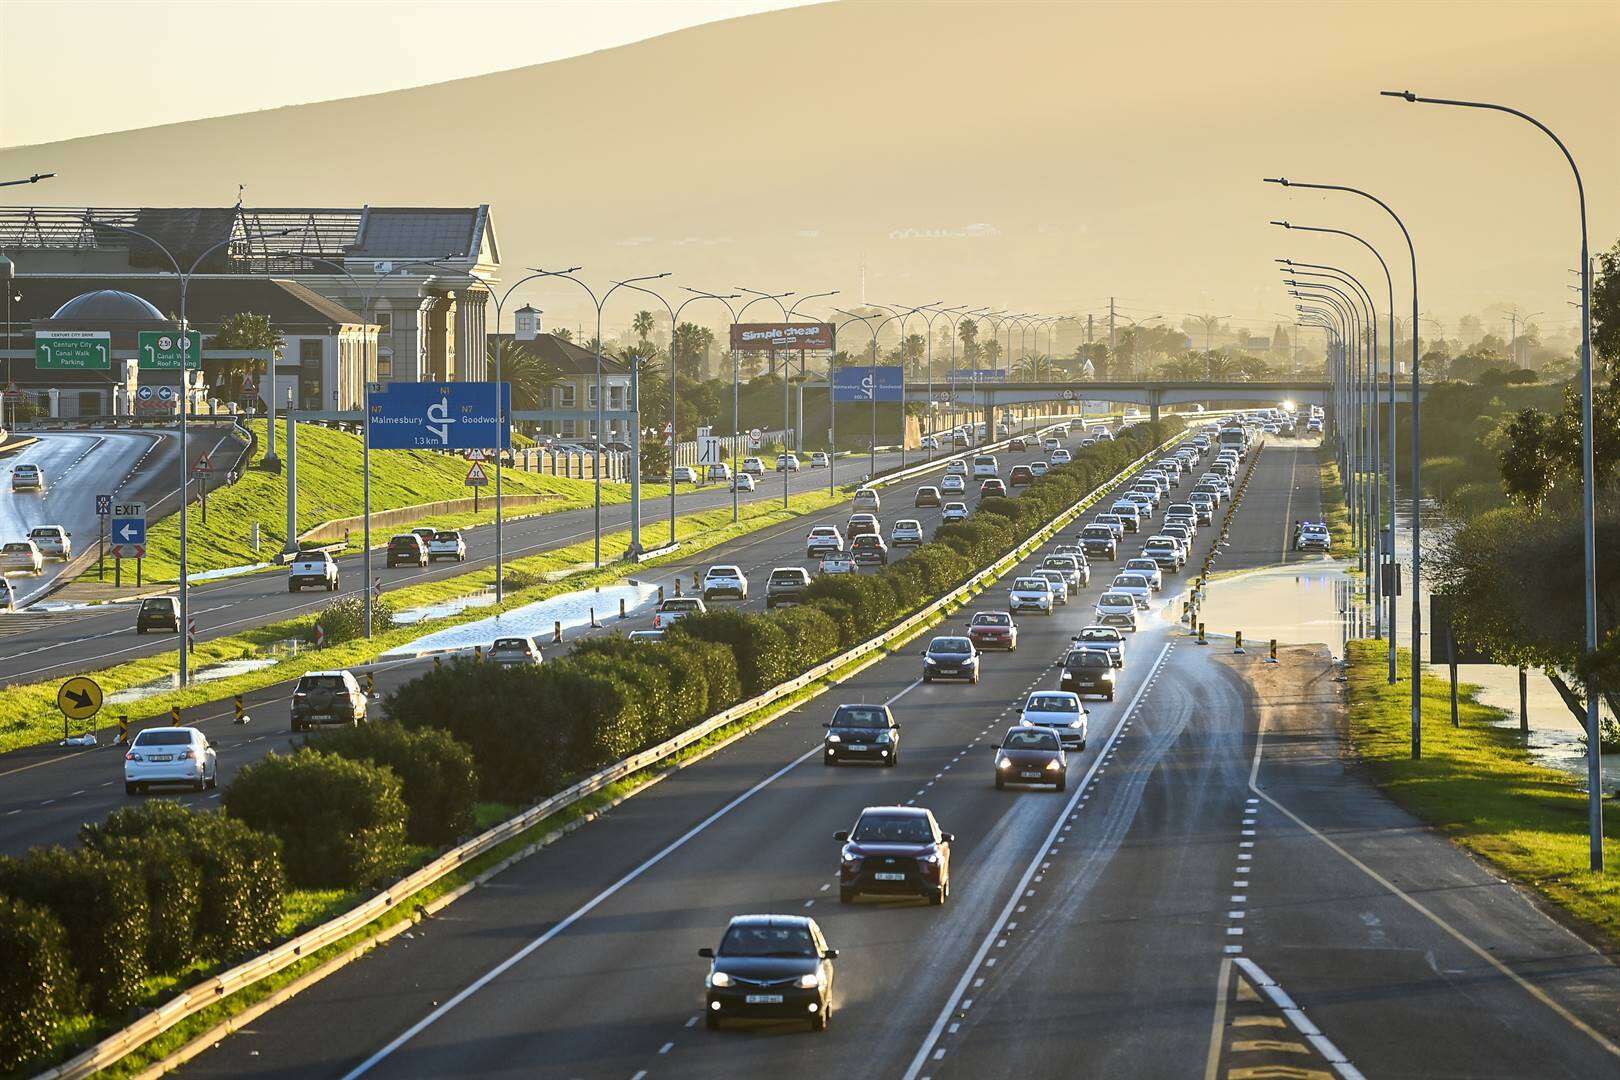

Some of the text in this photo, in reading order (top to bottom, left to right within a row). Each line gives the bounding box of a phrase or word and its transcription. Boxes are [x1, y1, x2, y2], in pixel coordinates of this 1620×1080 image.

[742, 326, 820, 340] Simple cheap
[53, 341, 93, 349] Century City
[61, 358, 85, 366] Parking
[173, 360, 197, 368] Paing
[371, 405, 383, 414] N7
[462, 405, 473, 414] N7
[371, 416, 423, 426] Malmesbury
[462, 416, 505, 424] Goodwod
[414, 437, 439, 445] 1.3 km
[115, 505, 141, 516] EXIT
